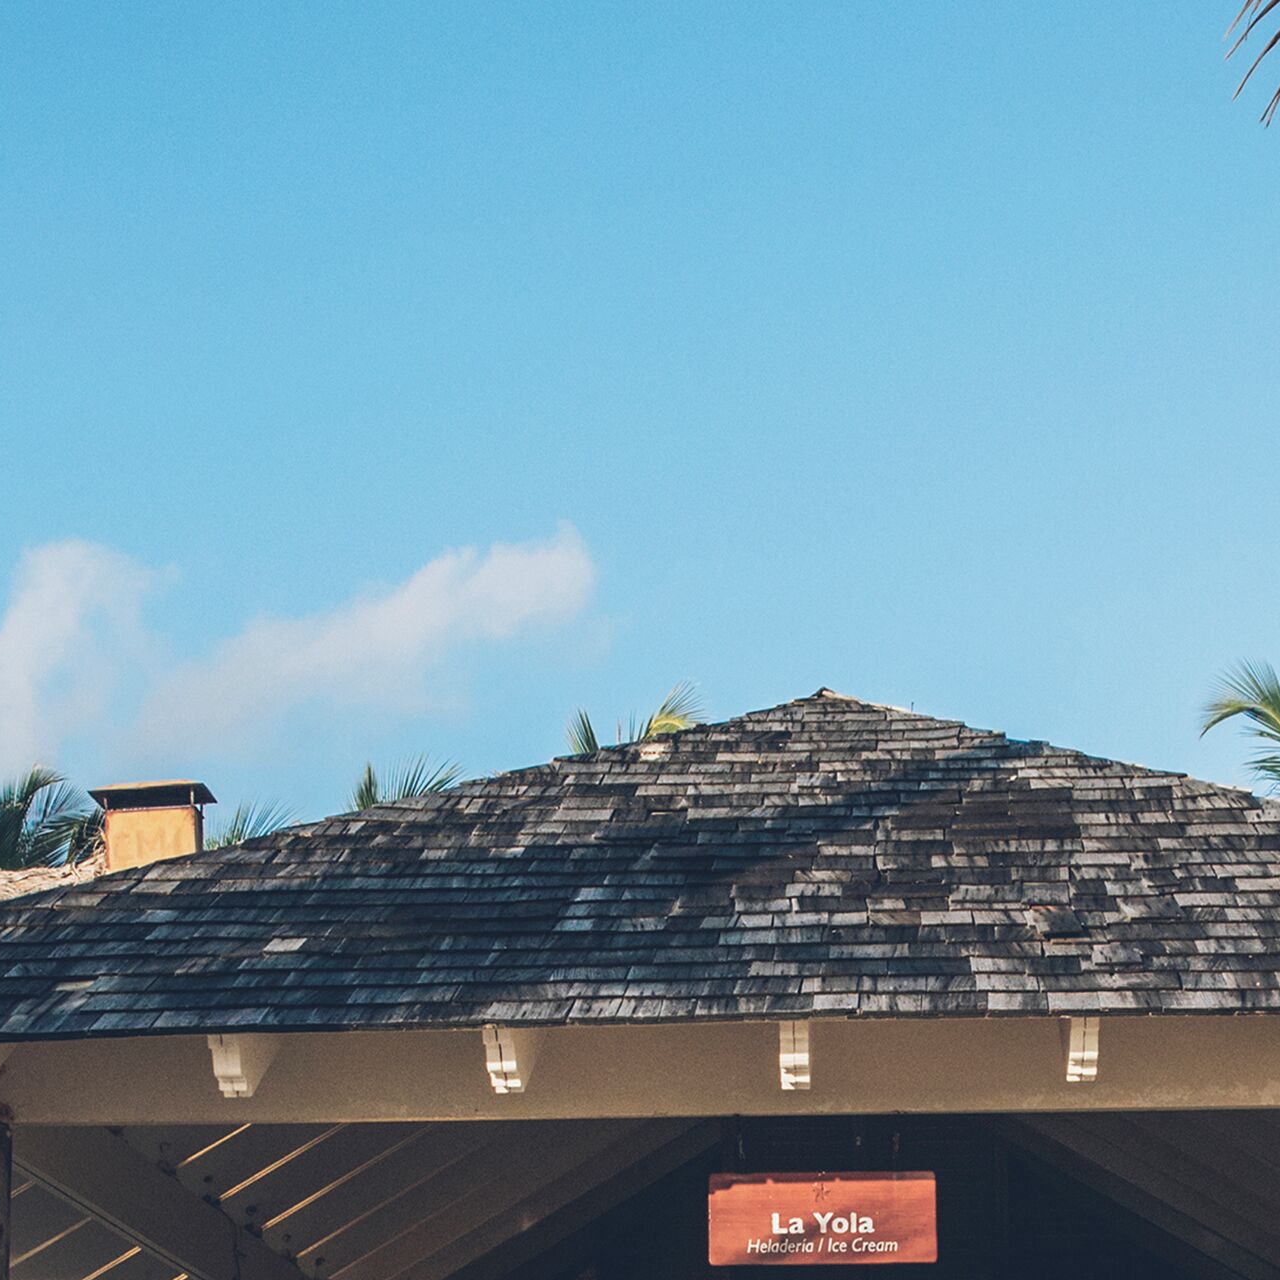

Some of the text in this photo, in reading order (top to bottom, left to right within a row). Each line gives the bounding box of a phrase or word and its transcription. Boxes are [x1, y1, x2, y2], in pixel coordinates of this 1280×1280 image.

[771, 1211, 875, 1234] La Yola
[827, 1237, 847, 1253] Ice
[851, 1237, 898, 1252] Cream
